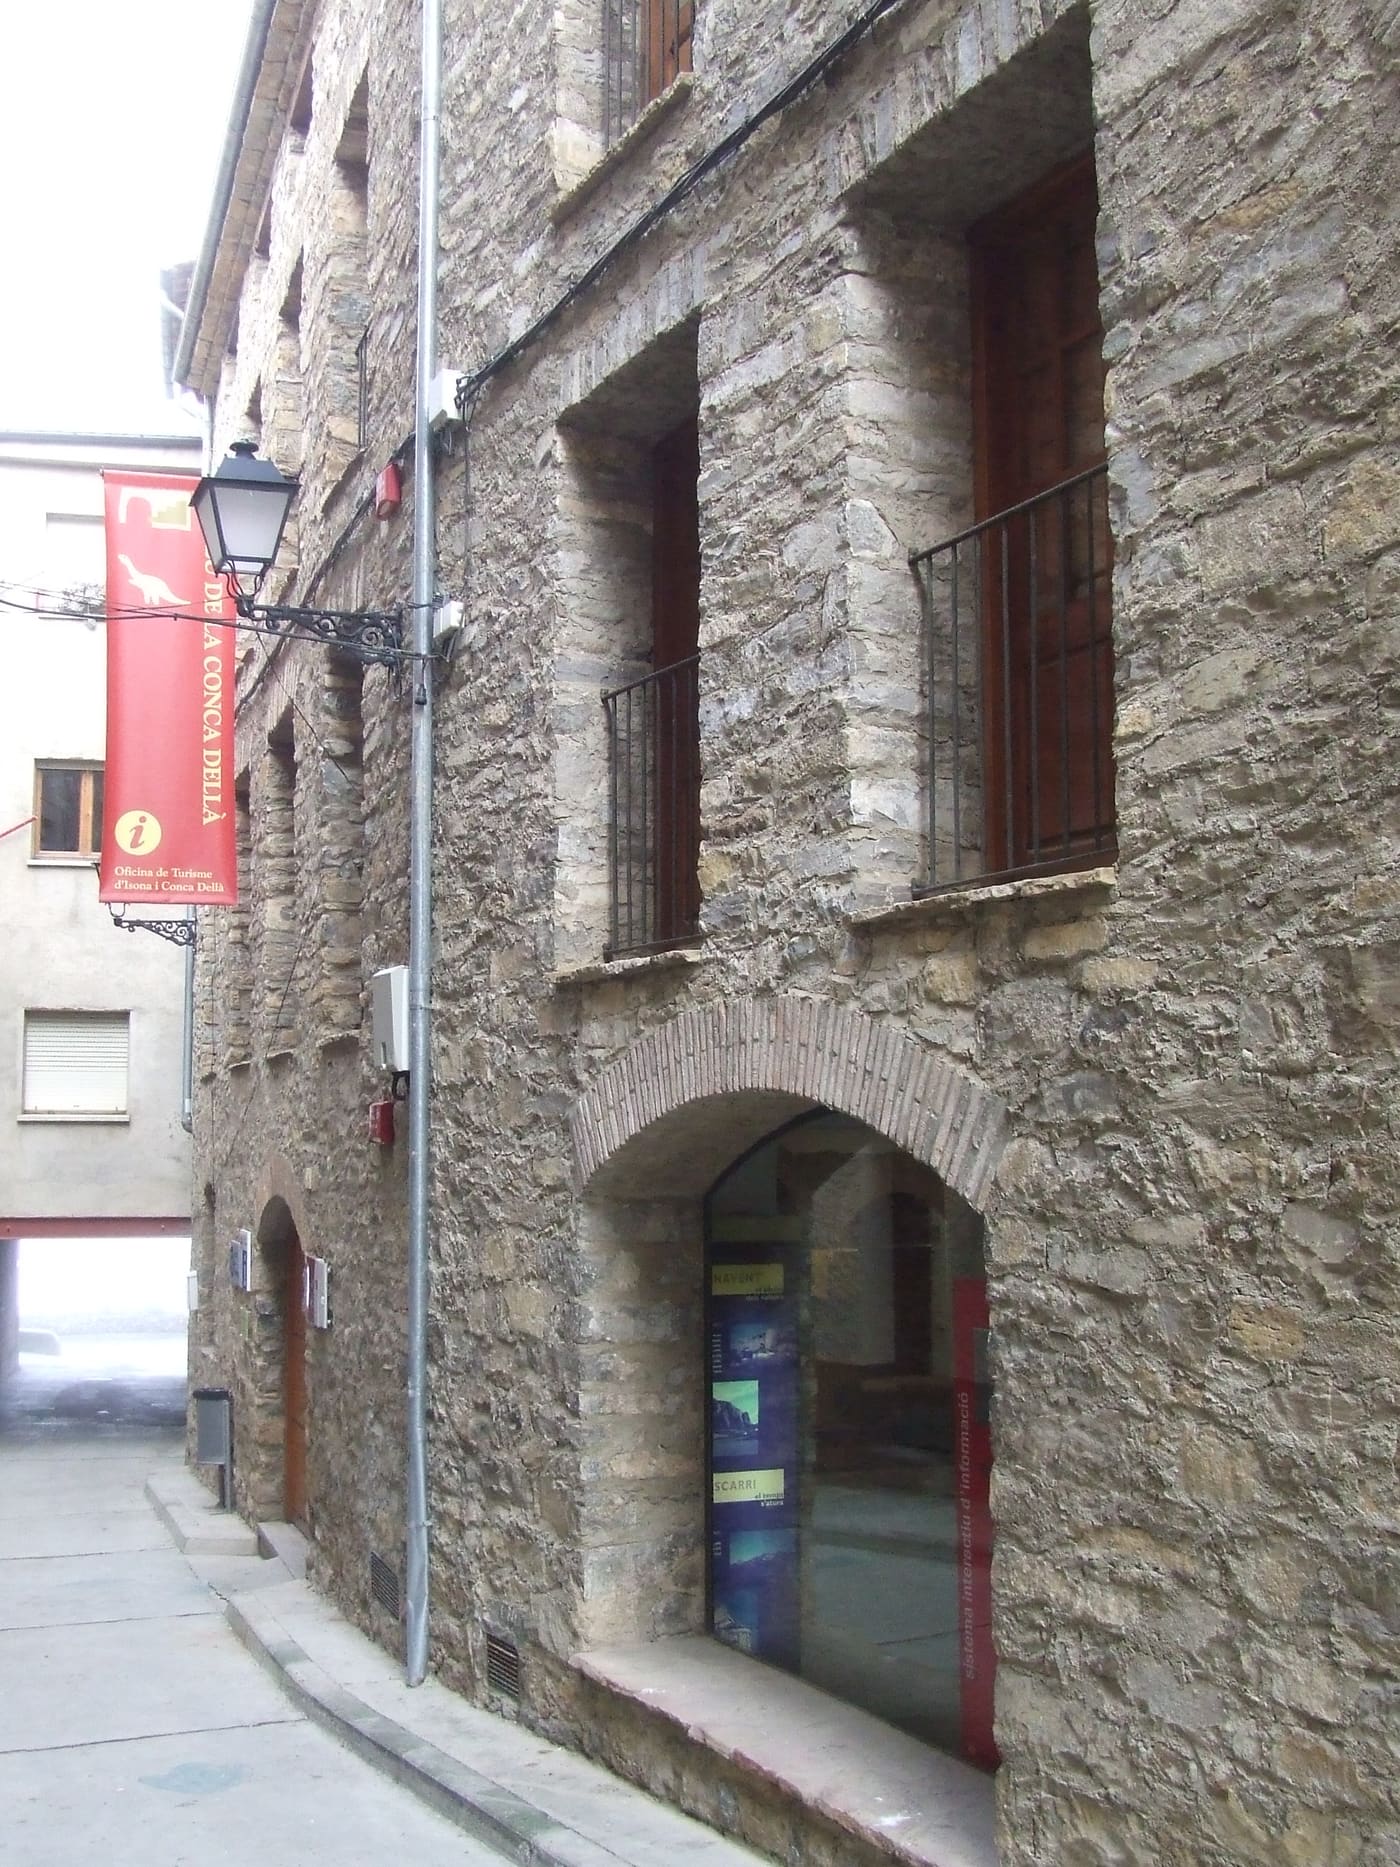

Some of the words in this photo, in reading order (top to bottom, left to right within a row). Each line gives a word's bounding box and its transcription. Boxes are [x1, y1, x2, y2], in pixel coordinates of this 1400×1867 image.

[204, 582, 223, 614] DE
[204, 622, 223, 650] LA
[203, 655, 223, 742] CONCA
[202, 748, 226, 826] DELLÀ
[114, 866, 154, 878] Oficina
[156, 867, 169, 878] de
[171, 867, 213, 879] Turisme
[114, 879, 152, 891] d'Isona
[161, 881, 194, 892] Conca
[197, 882, 225, 893] Dellà
[714, 1480, 756, 1491] SCARRI
[960, 1515, 974, 1602] interactiu
[963, 1607, 975, 1680] sistema
